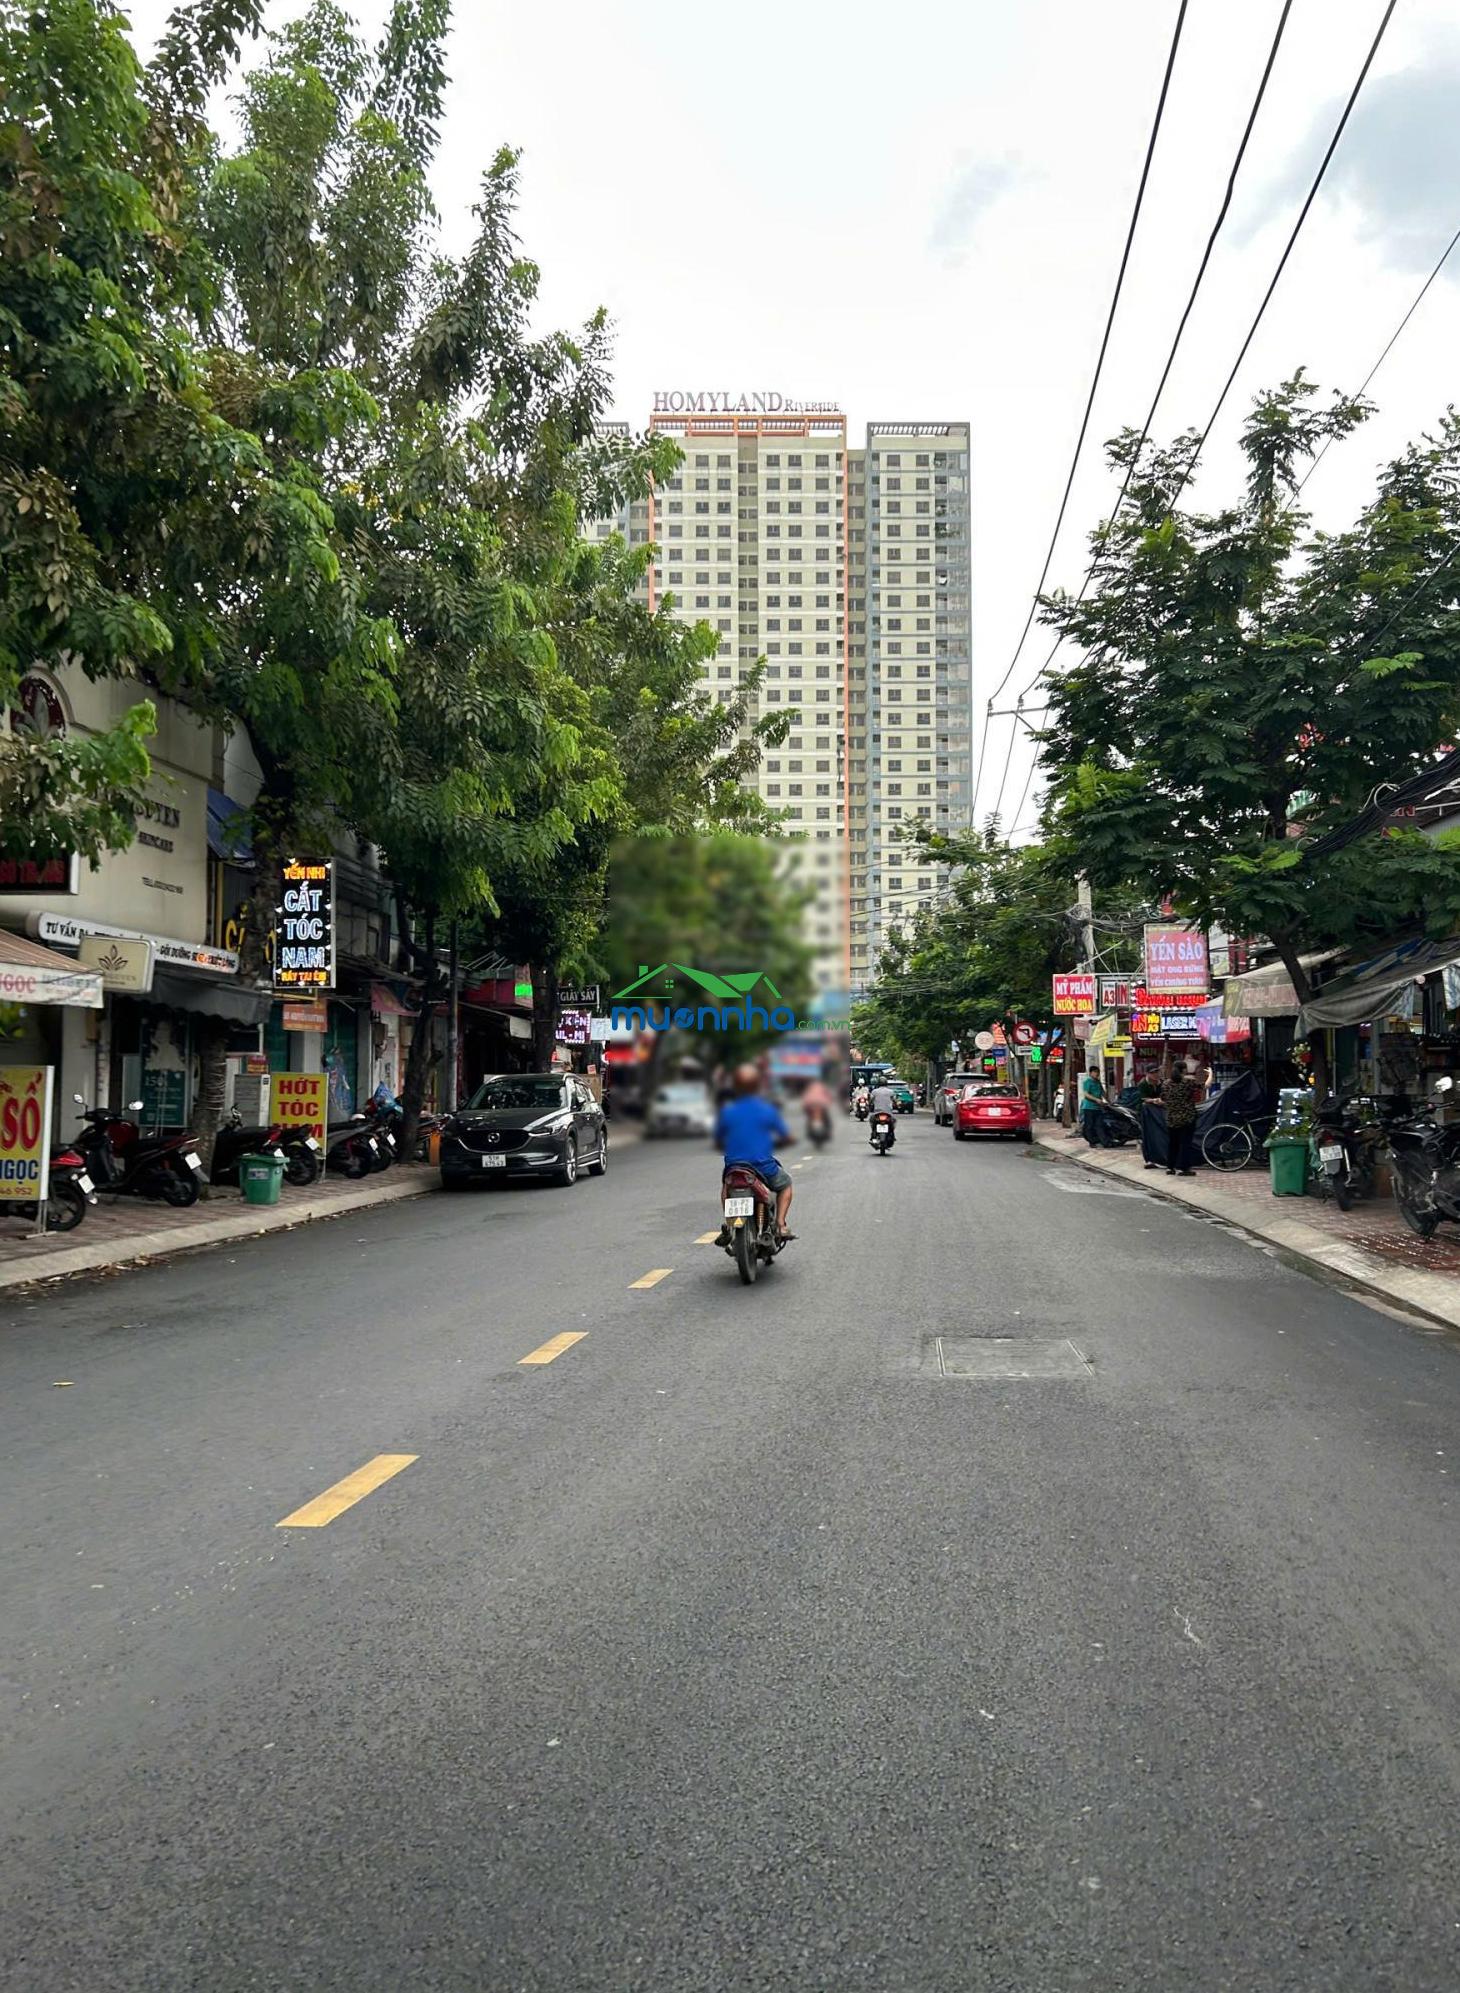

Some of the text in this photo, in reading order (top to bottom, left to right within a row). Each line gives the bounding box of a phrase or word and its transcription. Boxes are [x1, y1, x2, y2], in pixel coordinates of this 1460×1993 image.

[652, 391, 783, 412] HOMYLAND
[306, 866, 326, 880] NHI
[283, 913, 323, 940] TÓC
[281, 946, 325, 968] NAM
[1150, 935, 1176, 961] YẾN
[0, 972, 37, 998] GỌC
[1117, 984, 1127, 1005] IN
[1077, 998, 1092, 1011] HOA
[1104, 990, 1115, 1005] A3
[1148, 1023, 1160, 1032] A3
[278, 1077, 320, 1096] HỚT
[0, 1159, 39, 1184] GỌC
